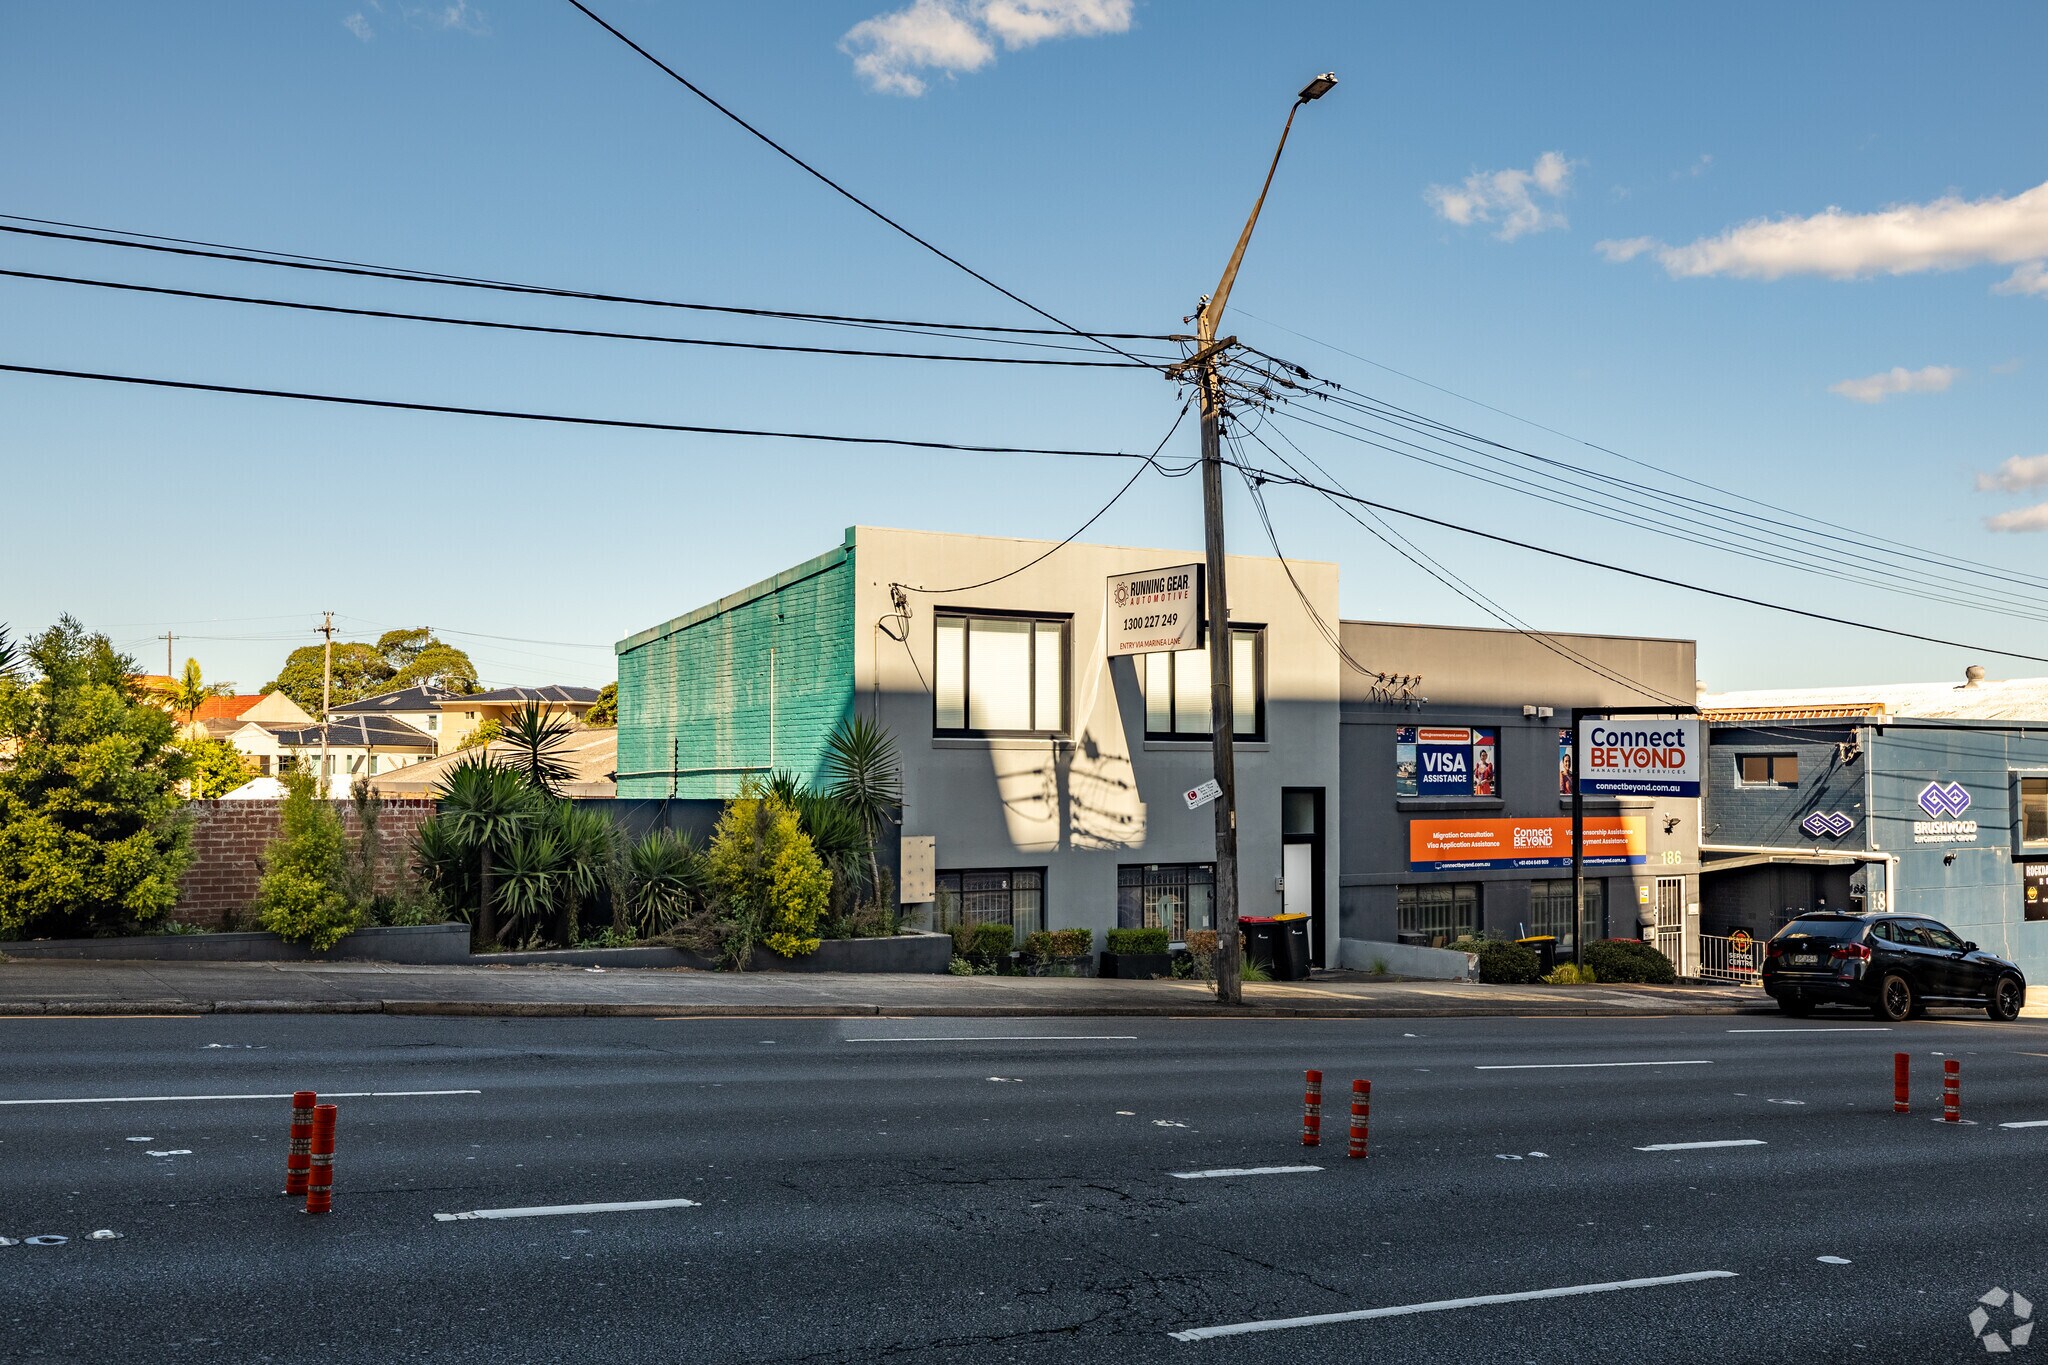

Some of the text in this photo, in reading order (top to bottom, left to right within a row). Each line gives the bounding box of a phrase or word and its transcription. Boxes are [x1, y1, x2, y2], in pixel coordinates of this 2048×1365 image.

[1130, 574, 1189, 596] RUNNING GEAR
[1130, 590, 1188, 606] AUTOMOTIVE
[1124, 613, 1178, 630] 1300 227 249
[1120, 642, 1135, 650] ENTRY
[1168, 637, 1180, 645] LANE
[1591, 728, 1685, 747] Connect
[1423, 752, 1466, 772] VISA
[1591, 748, 1686, 768] BEYOND
[1423, 774, 1467, 783] ASSISTANCE
[1596, 783, 1680, 792] connectbeyond.com.au
[1514, 827, 1552, 836] Connect
[1914, 821, 1977, 834] BRUSHWOOD
[1433, 832, 1459, 840] Migration
[1514, 837, 1552, 846] BEYOND
[1440, 841, 1470, 850] Application
[1661, 850, 1682, 864] 186
